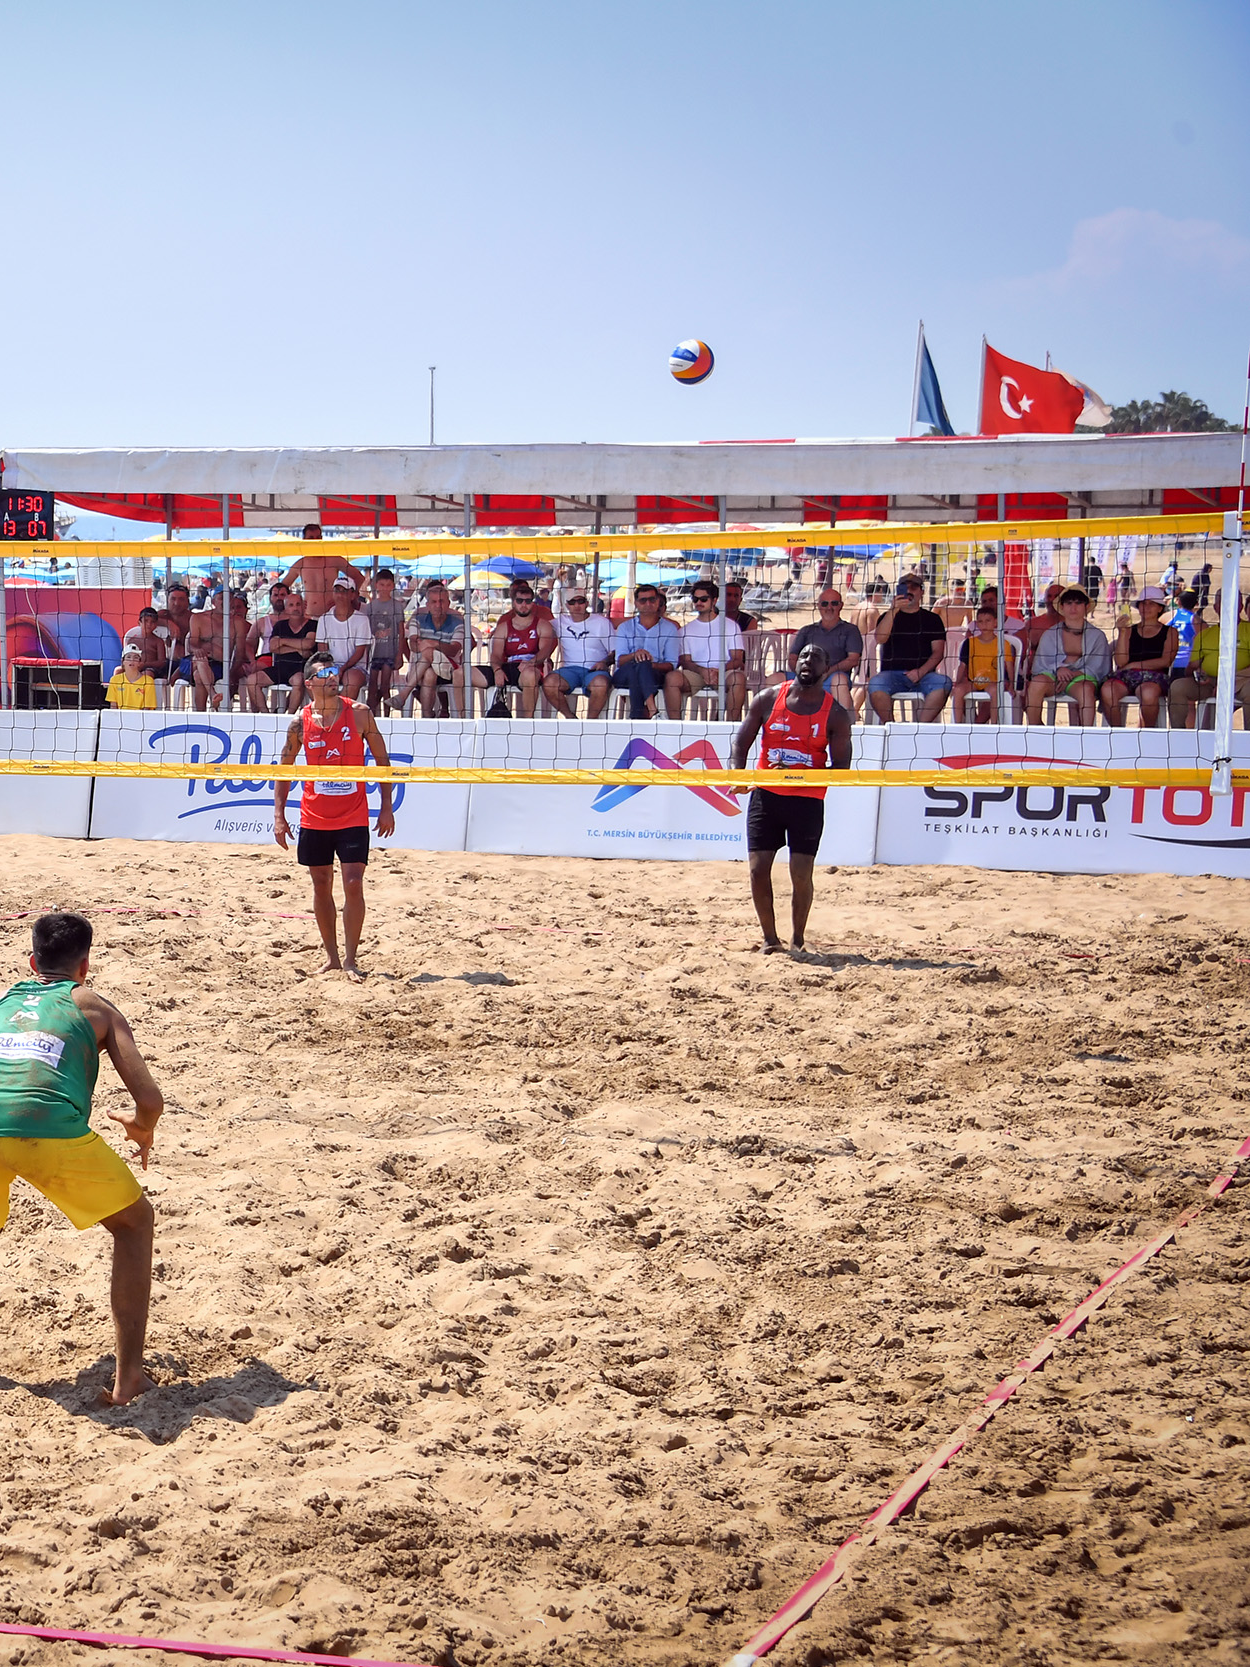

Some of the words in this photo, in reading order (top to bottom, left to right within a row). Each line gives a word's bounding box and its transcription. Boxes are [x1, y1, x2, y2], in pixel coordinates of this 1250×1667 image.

[8, 495, 43, 513] 11:30
[3, 511, 10, 521] A
[34, 512, 40, 522] B
[3, 519, 17, 537] 13
[27, 520, 47, 537] 07
[528, 629, 536, 638] 2
[341, 726, 351, 742] 2
[811, 723, 820, 738] 1
[923, 785, 1110, 824] SPOR
[213, 819, 264, 834] Alışveriş
[924, 822, 1000, 835] TEŞKİLAT
[1008, 825, 1109, 839] BAŞKANLIĞI
[587, 829, 601, 837] T.C.
[603, 828, 636, 838] MERSİN
[638, 830, 693, 841] BÜYÜKŞEHİR
[695, 832, 742, 842] BELEDİYESİ
